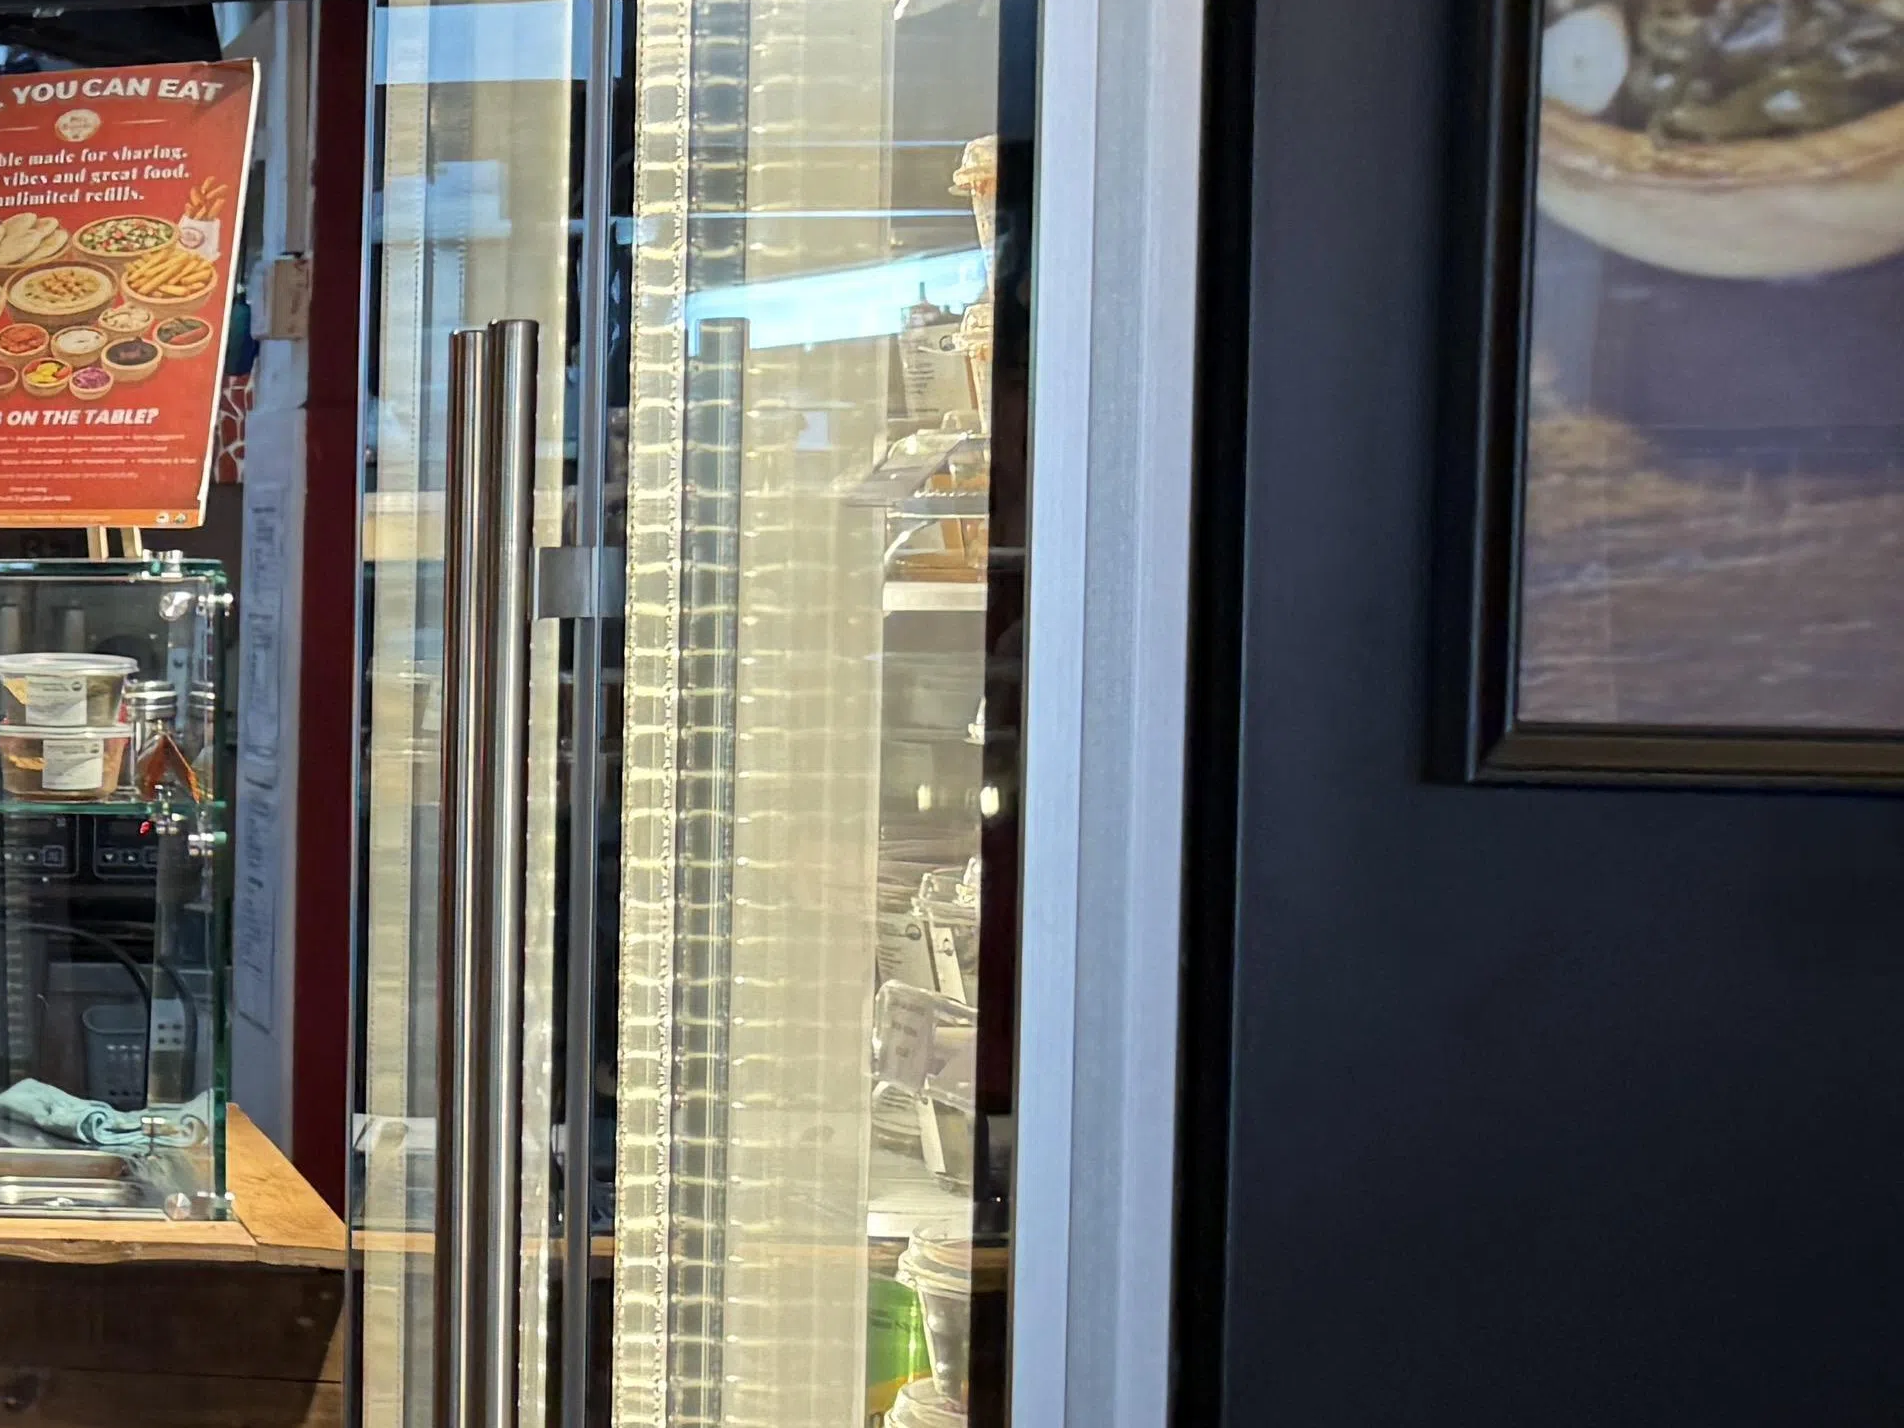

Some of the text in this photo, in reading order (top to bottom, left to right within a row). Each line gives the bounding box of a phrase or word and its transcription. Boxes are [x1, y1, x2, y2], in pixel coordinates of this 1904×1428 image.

[12, 80, 78, 105] YOU
[82, 77, 151, 98] CAN
[157, 78, 223, 101] EAT
[28, 150, 73, 166] made
[80, 148, 107, 163] for
[3, 170, 48, 187] vibes
[53, 168, 85, 184] and
[91, 166, 138, 183] great
[7, 410, 39, 426] ON
[42, 410, 80, 425] THE
[85, 408, 159, 425] TABLE?
